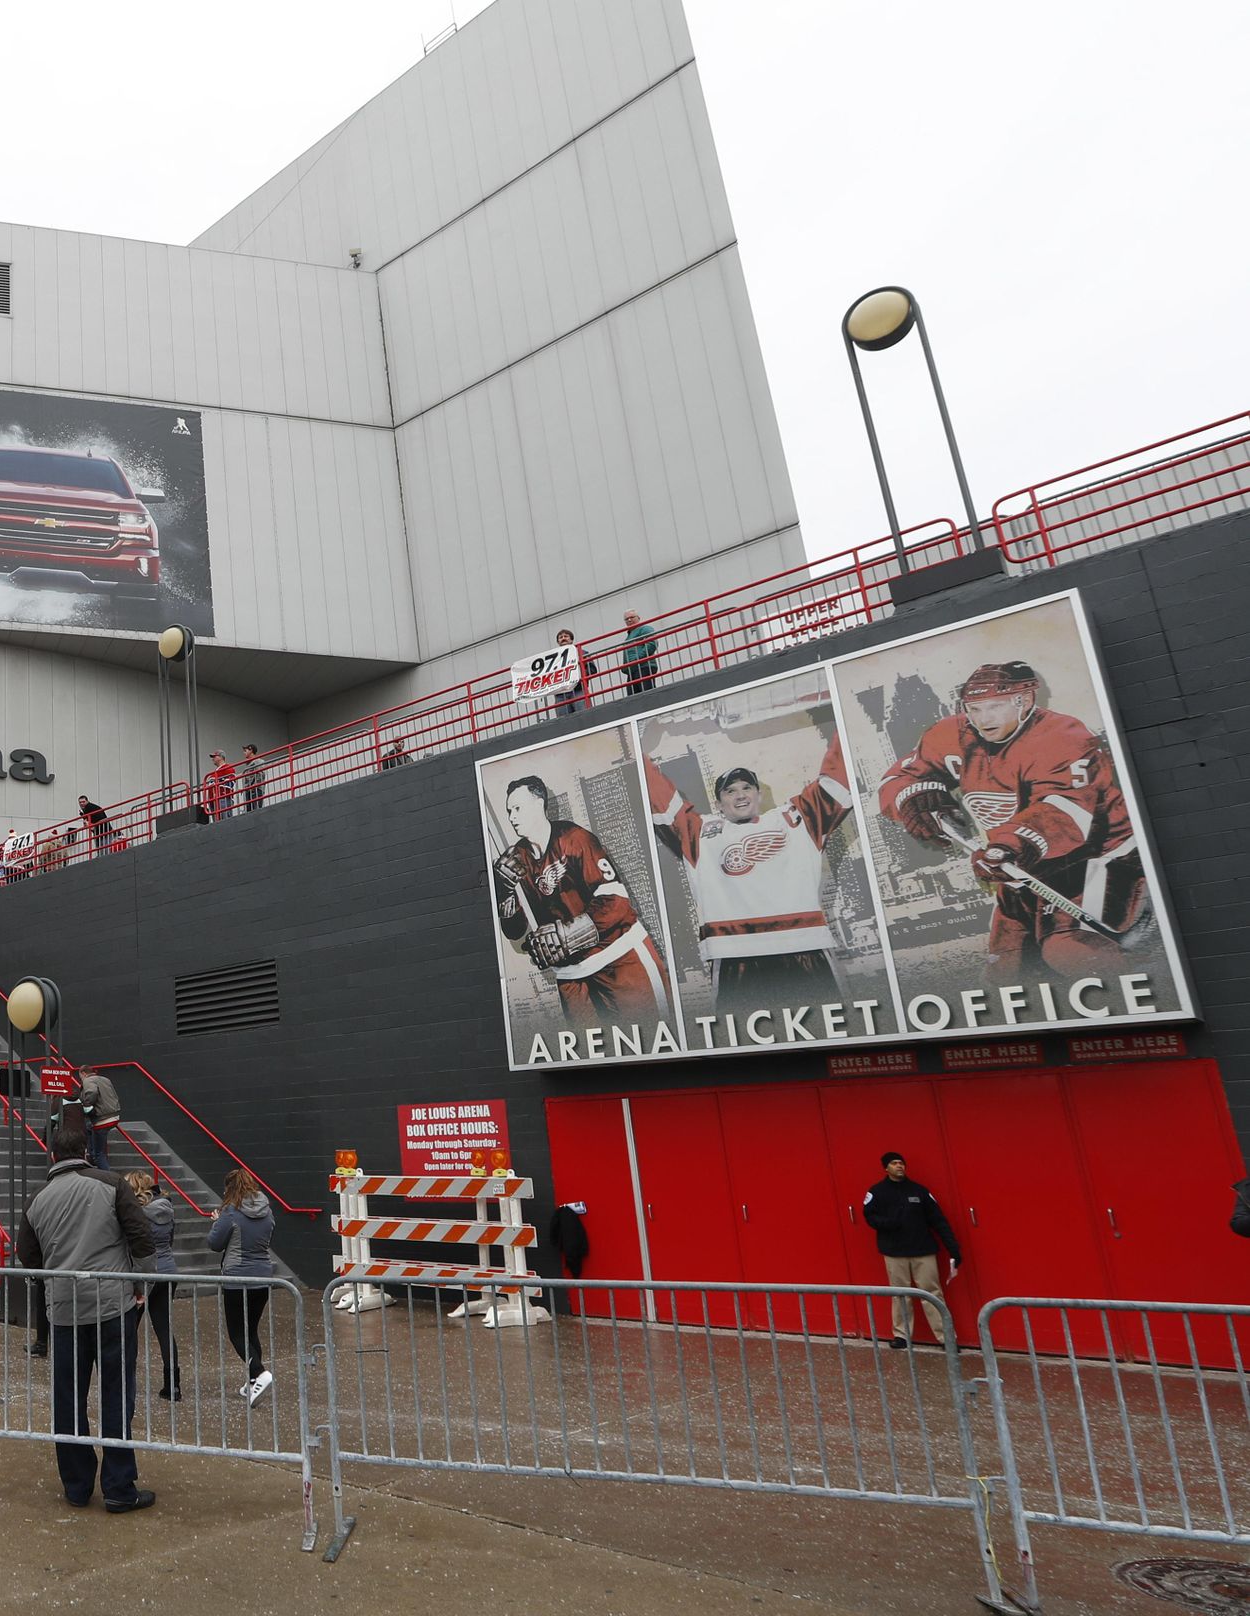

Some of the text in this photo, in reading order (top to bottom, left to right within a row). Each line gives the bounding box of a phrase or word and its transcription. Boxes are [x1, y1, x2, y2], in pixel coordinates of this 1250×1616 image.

[784, 599, 840, 624] UPPER
[531, 648, 569, 677] 97.1
[515, 664, 578, 695] TICKET
[944, 754, 962, 779] C
[597, 858, 616, 881] 9
[528, 973, 1156, 1065] ARENA TICKET OFFICE
[945, 1045, 1037, 1059] ENTER HERE
[1072, 1035, 1178, 1052] ENTER HERE
[831, 1054, 912, 1068] ENTER HERE
[411, 1104, 491, 1121] JOE LOUIS ARENA
[406, 1121, 499, 1137] BOX OFFICE HOURS:
[406, 1141, 433, 1150] Monday
[435, 1139, 462, 1149] through
[463, 1138, 496, 1149] Saturday
[431, 1151, 450, 1160] 10am
[451, 1151, 458, 1160] to
[424, 1163, 439, 1171] Open
